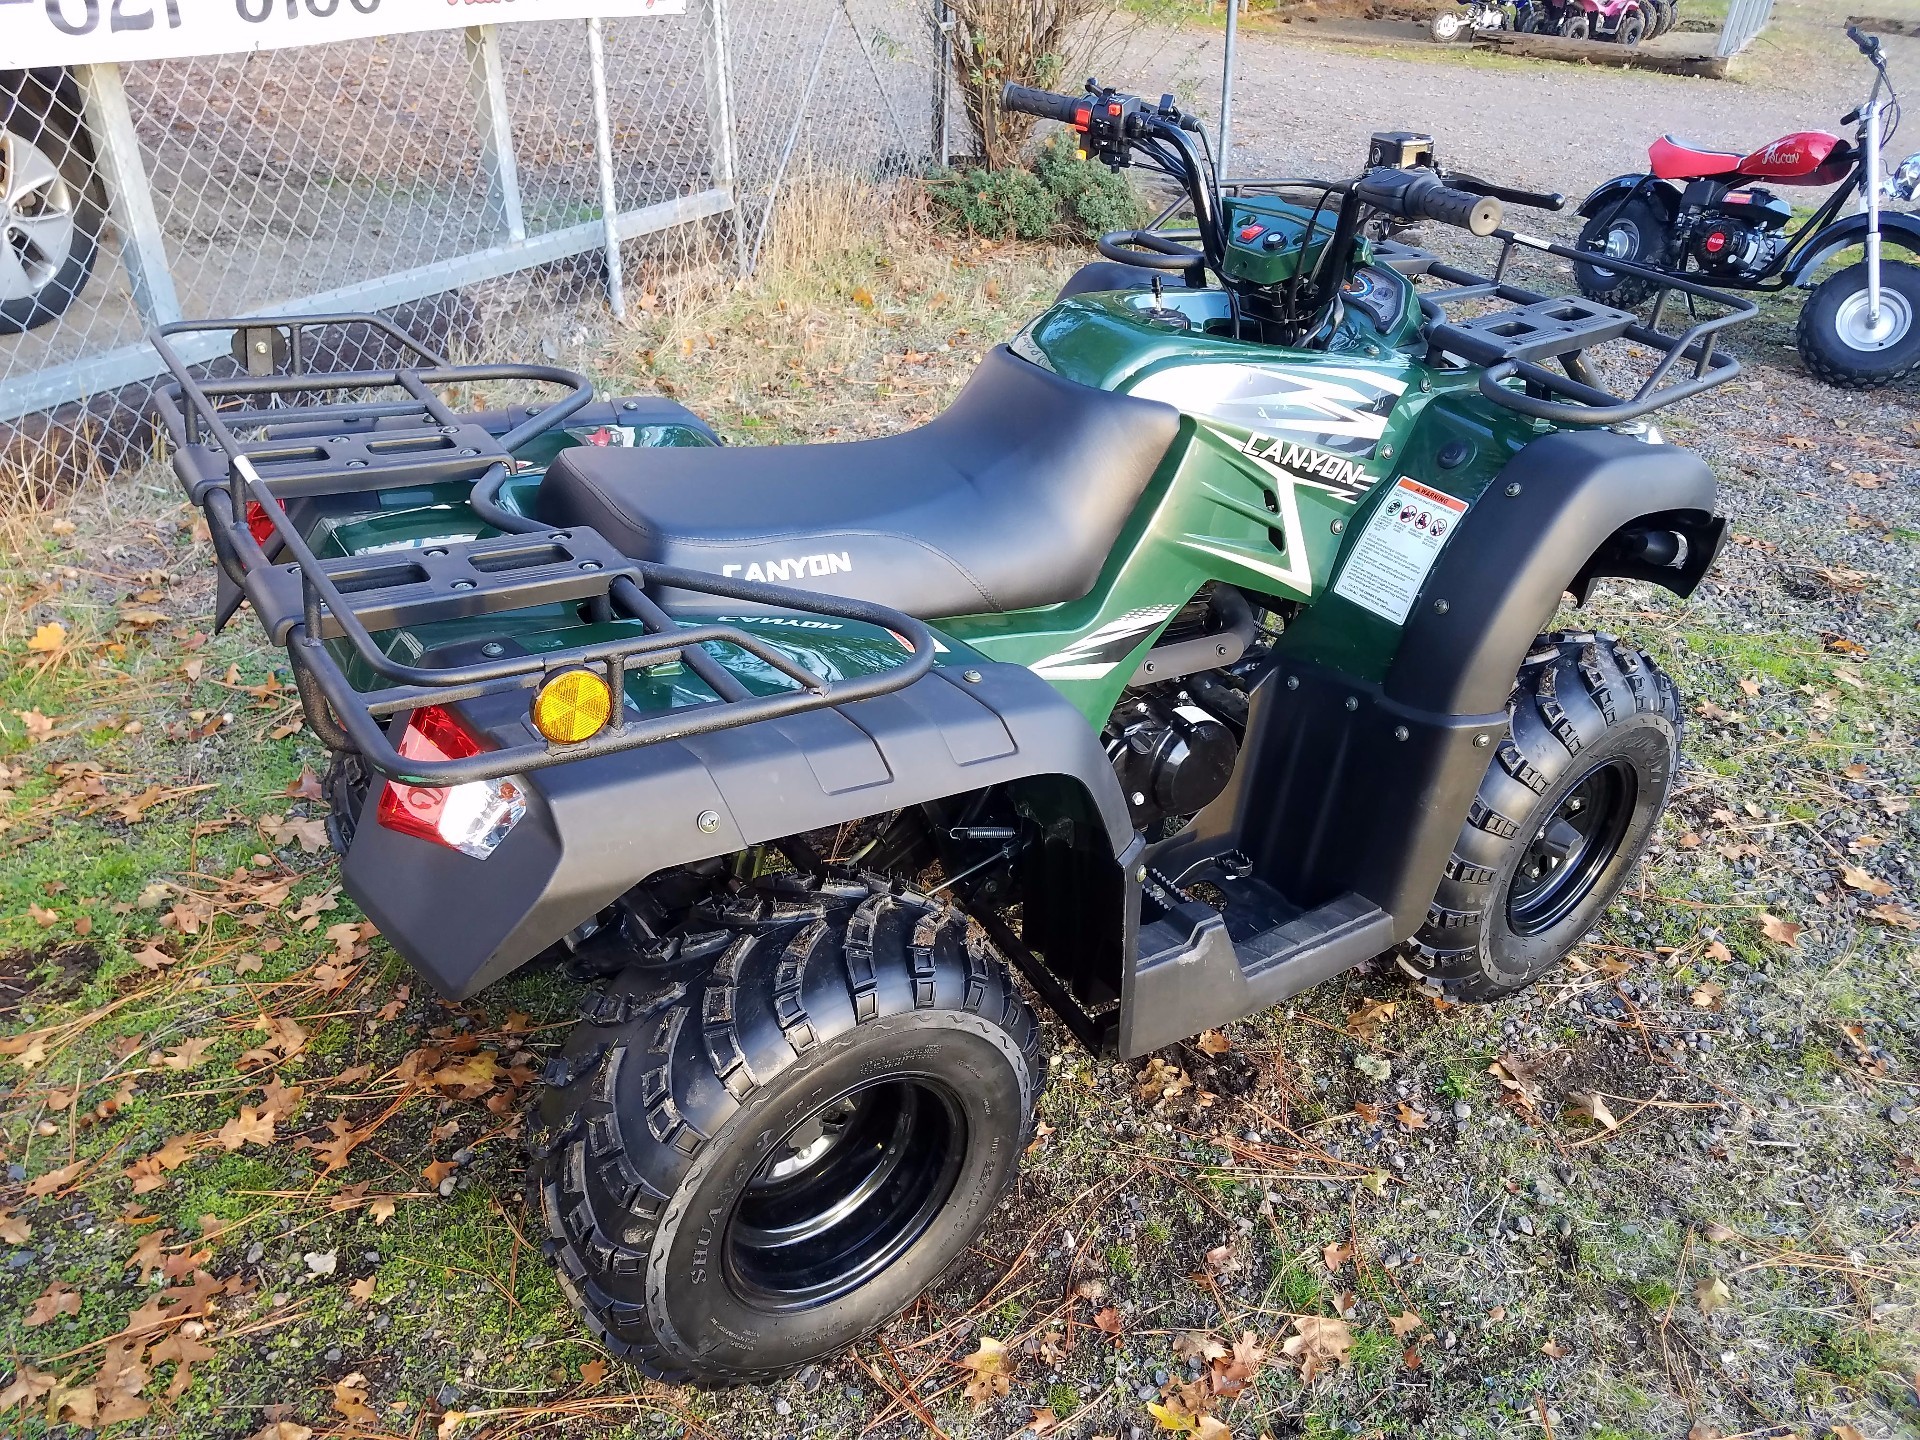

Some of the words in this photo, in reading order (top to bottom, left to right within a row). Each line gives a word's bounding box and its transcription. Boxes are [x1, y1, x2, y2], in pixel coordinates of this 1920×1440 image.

[1243, 431, 1366, 486] CANYON
[1420, 488, 1450, 505] WARNING
[722, 552, 852, 583] CANYON
